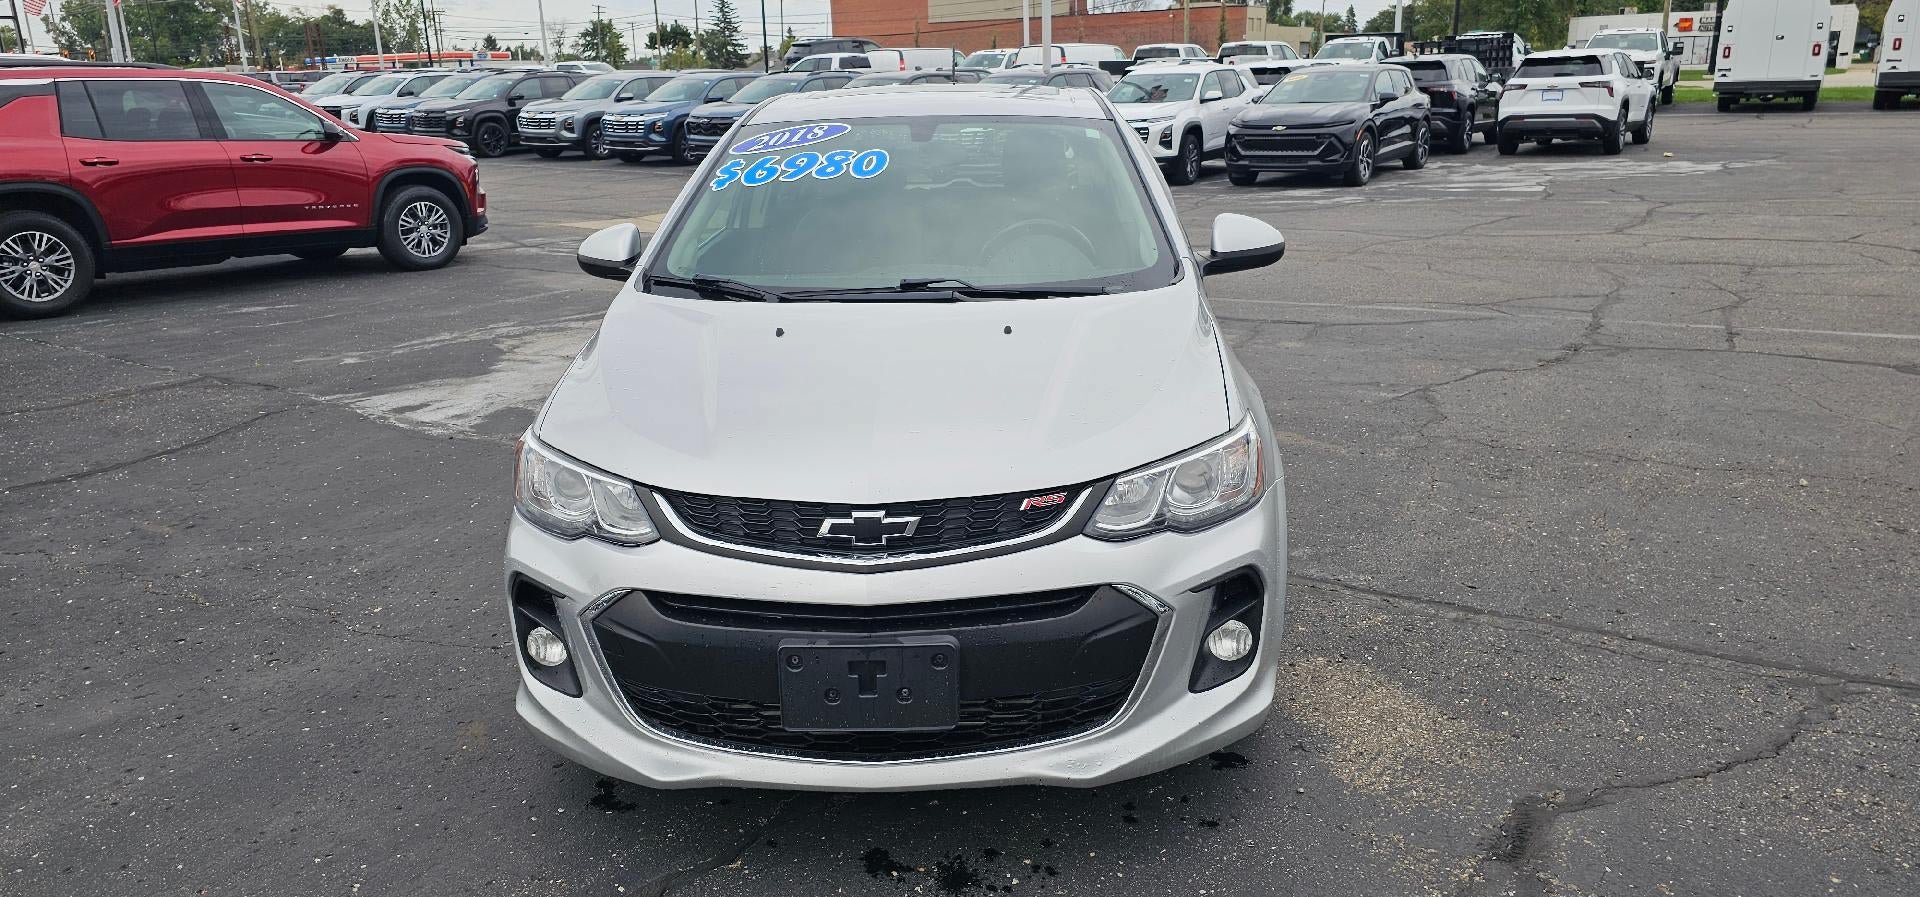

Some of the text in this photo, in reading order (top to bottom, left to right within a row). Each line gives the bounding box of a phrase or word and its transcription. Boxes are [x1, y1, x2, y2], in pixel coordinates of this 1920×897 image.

[747, 125, 829, 151] 2018
[710, 149, 889, 191] $6980
[1020, 492, 1067, 510] RS
